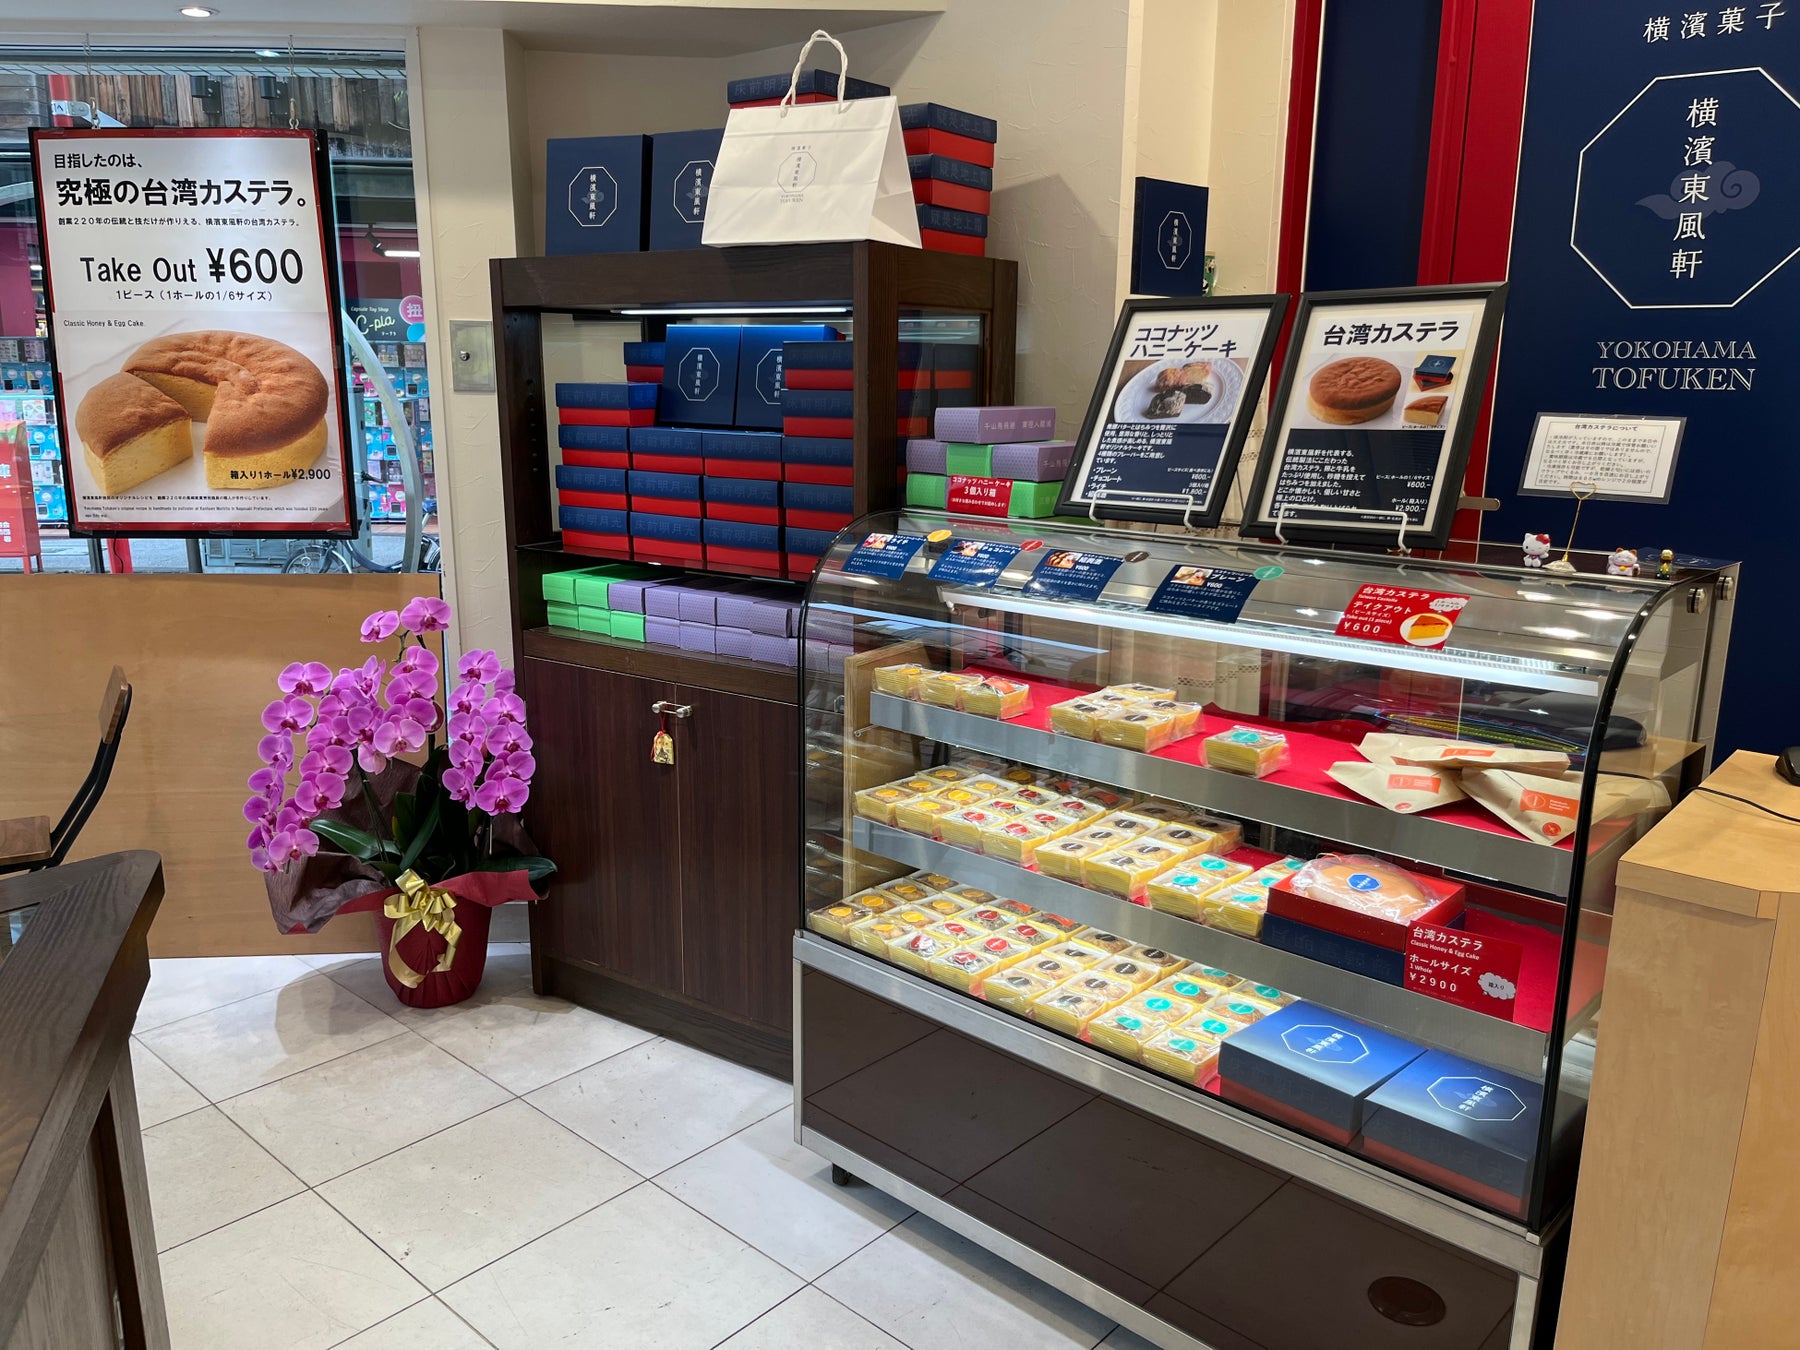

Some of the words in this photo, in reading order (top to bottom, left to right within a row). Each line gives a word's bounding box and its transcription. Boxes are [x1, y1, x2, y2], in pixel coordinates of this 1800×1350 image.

[1643, 0, 1788, 43] 横濱菓子
[54, 153, 143, 169] 目指したのは、
[56, 178, 306, 207] 究極の台湾カステラ。
[1670, 97, 1719, 279] 横濱東風軒
[80, 257, 142, 282] Take
[152, 257, 197, 282] Out
[206, 247, 304, 284] ¥600
[87, 320, 105, 328] Honey
[114, 320, 125, 328] Egg
[1135, 325, 1218, 342] ココナッツ
[1323, 320, 1460, 346] 台湾カステラ
[1130, 340, 1237, 358] ハニーケーキ
[1597, 340, 1757, 361] YOKOHAMA
[1592, 366, 1757, 391] TOFUKEN
[1575, 424, 1638, 432] 台湾カステラについて
[1210, 574, 1246, 583] プレーン
[1362, 586, 1430, 600] 台湾カステラ
[1353, 601, 1412, 615] テイクアウト
[1413, 926, 1483, 951] 台湾カステラ
[1410, 939, 1429, 949] Classic
[1429, 944, 1448, 954] Honey
[1454, 949, 1465, 958] Egg
[1465, 952, 1480, 961] Cake
[1409, 953, 1472, 976] ホールサイズ
[1414, 965, 1433, 974] Whole
